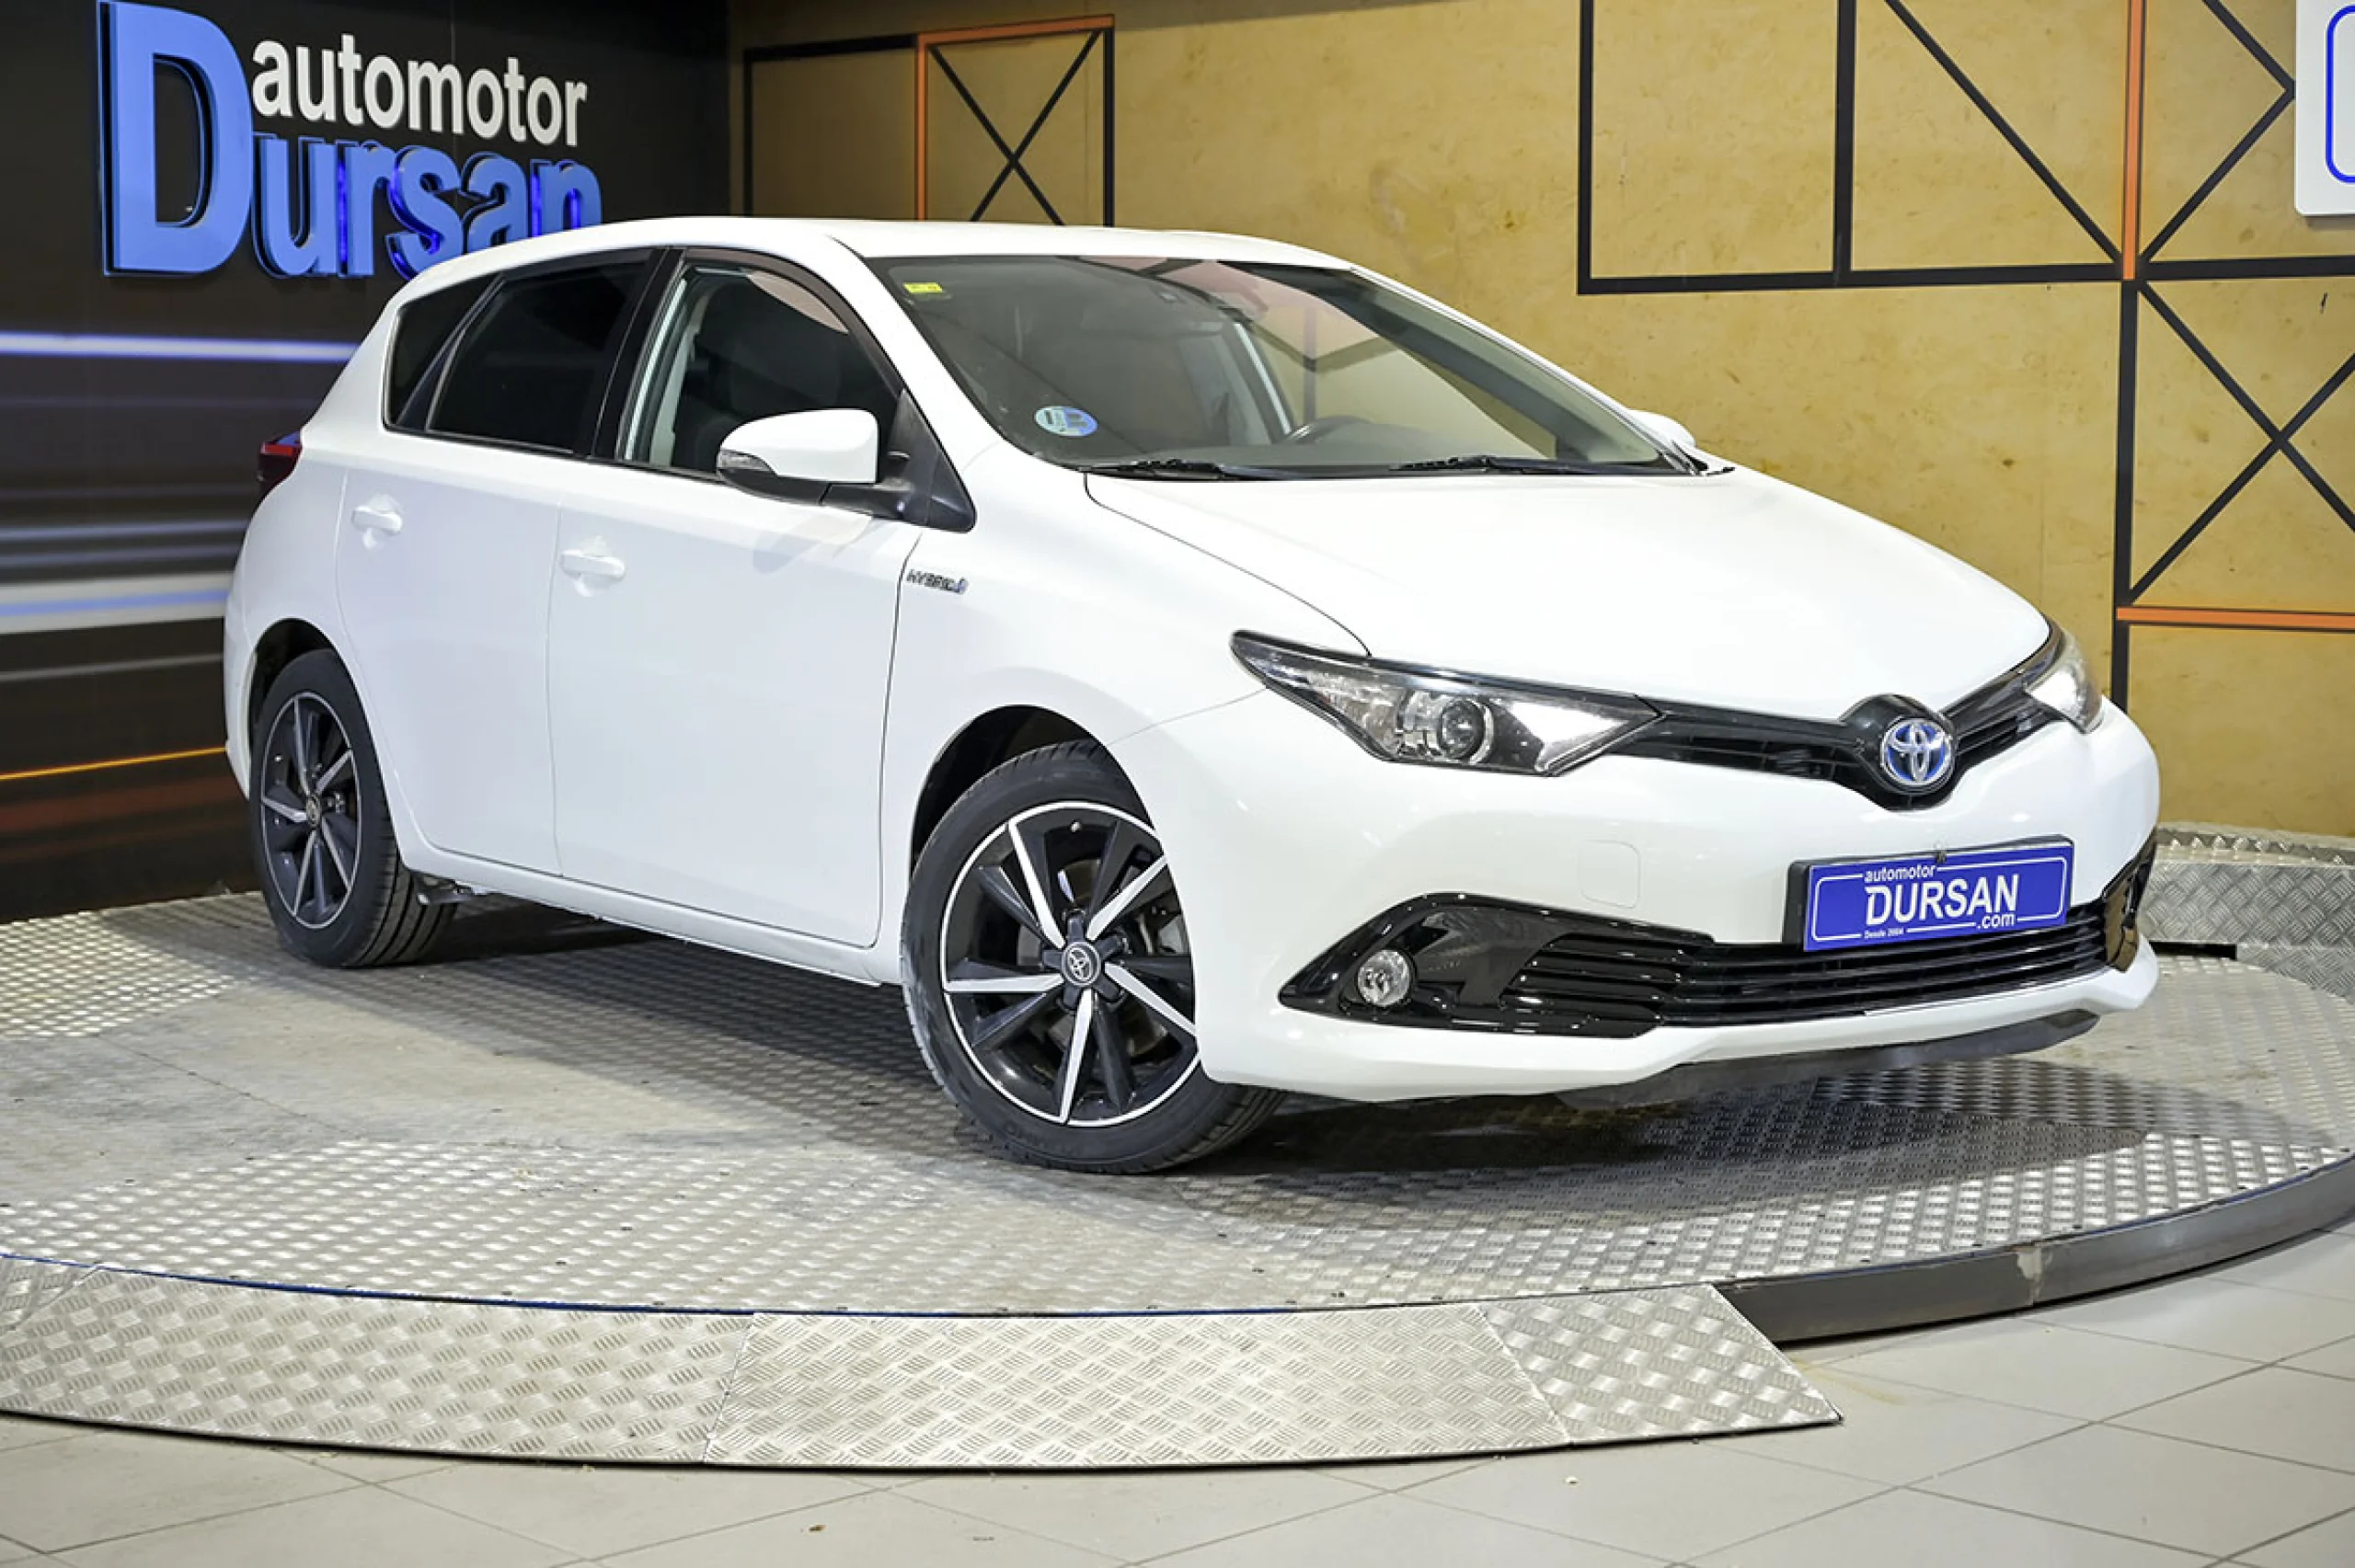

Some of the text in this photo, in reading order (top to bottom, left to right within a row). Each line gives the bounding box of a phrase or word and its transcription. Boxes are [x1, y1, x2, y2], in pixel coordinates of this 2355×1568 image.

[252, 33, 587, 146] automotor
[97, 0, 603, 278] Dursan
[1864, 864, 1936, 884] automotor
[1865, 873, 2019, 926] DURSAN
[1977, 912, 2016, 929] .com
